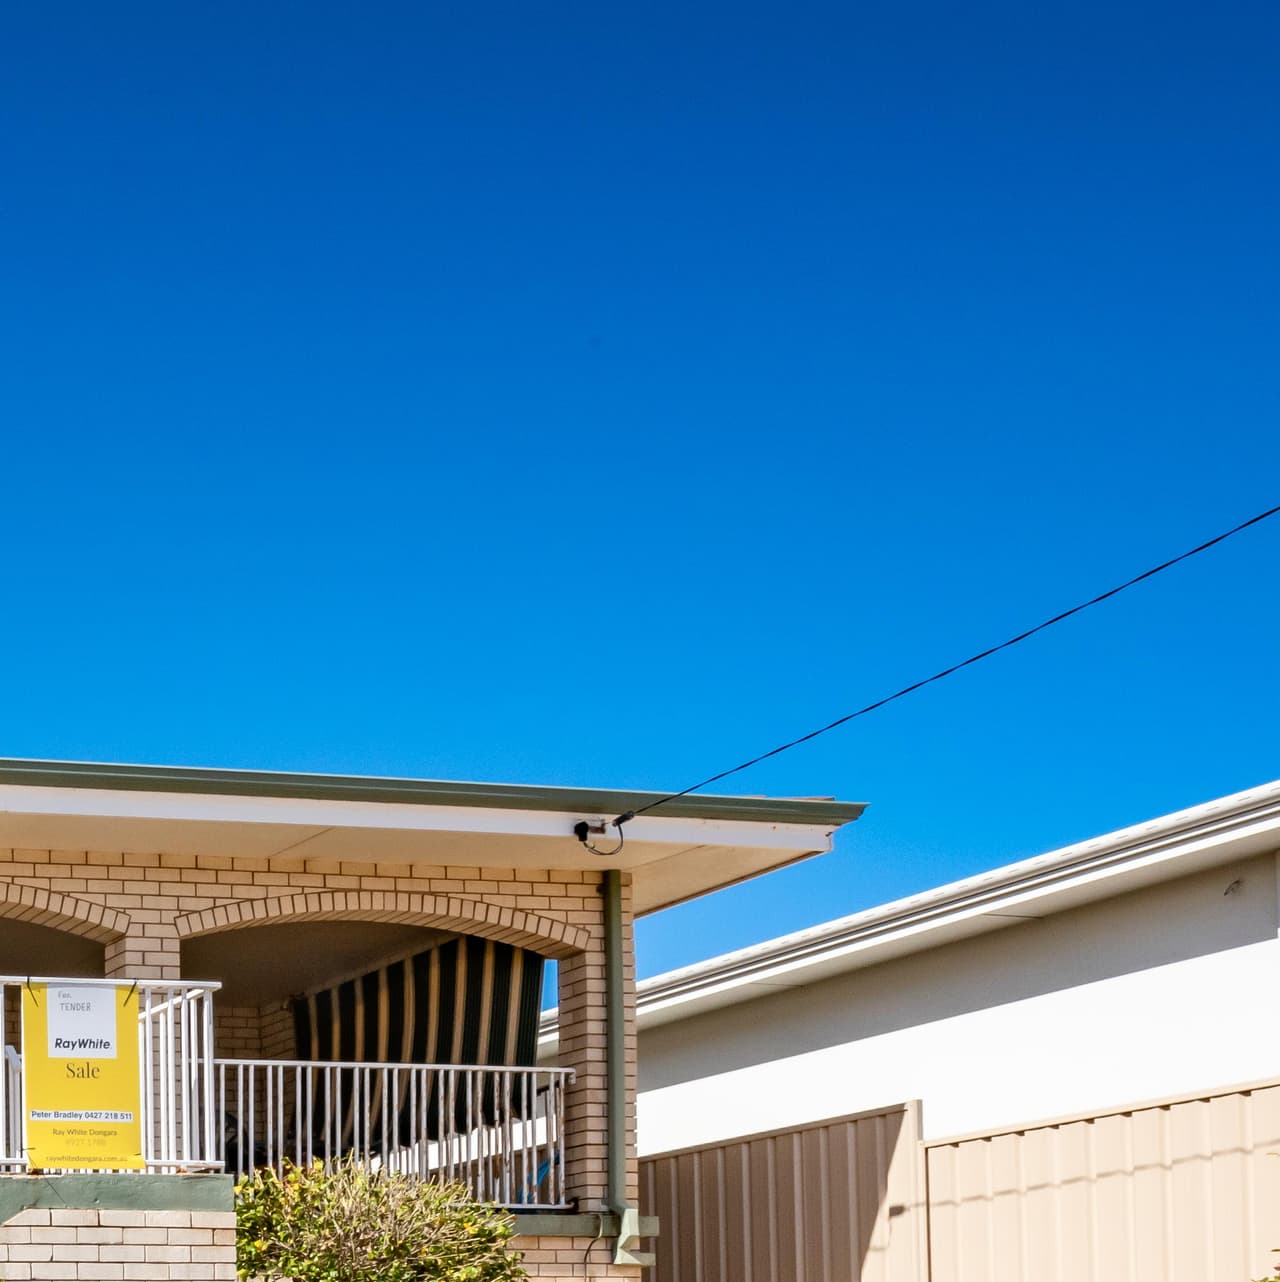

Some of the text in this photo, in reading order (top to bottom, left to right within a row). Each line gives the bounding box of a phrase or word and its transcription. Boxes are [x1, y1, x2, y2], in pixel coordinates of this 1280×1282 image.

[60, 1002, 91, 1012] TENDER
[66, 1061, 101, 1079] Sale
[31, 1110, 51, 1119] Peter
[53, 1111, 82, 1120] Bradley
[105, 1112, 118, 1120] 218
[120, 1112, 132, 1120] 511
[52, 1128, 65, 1136] Ray
[67, 1128, 87, 1136] White
